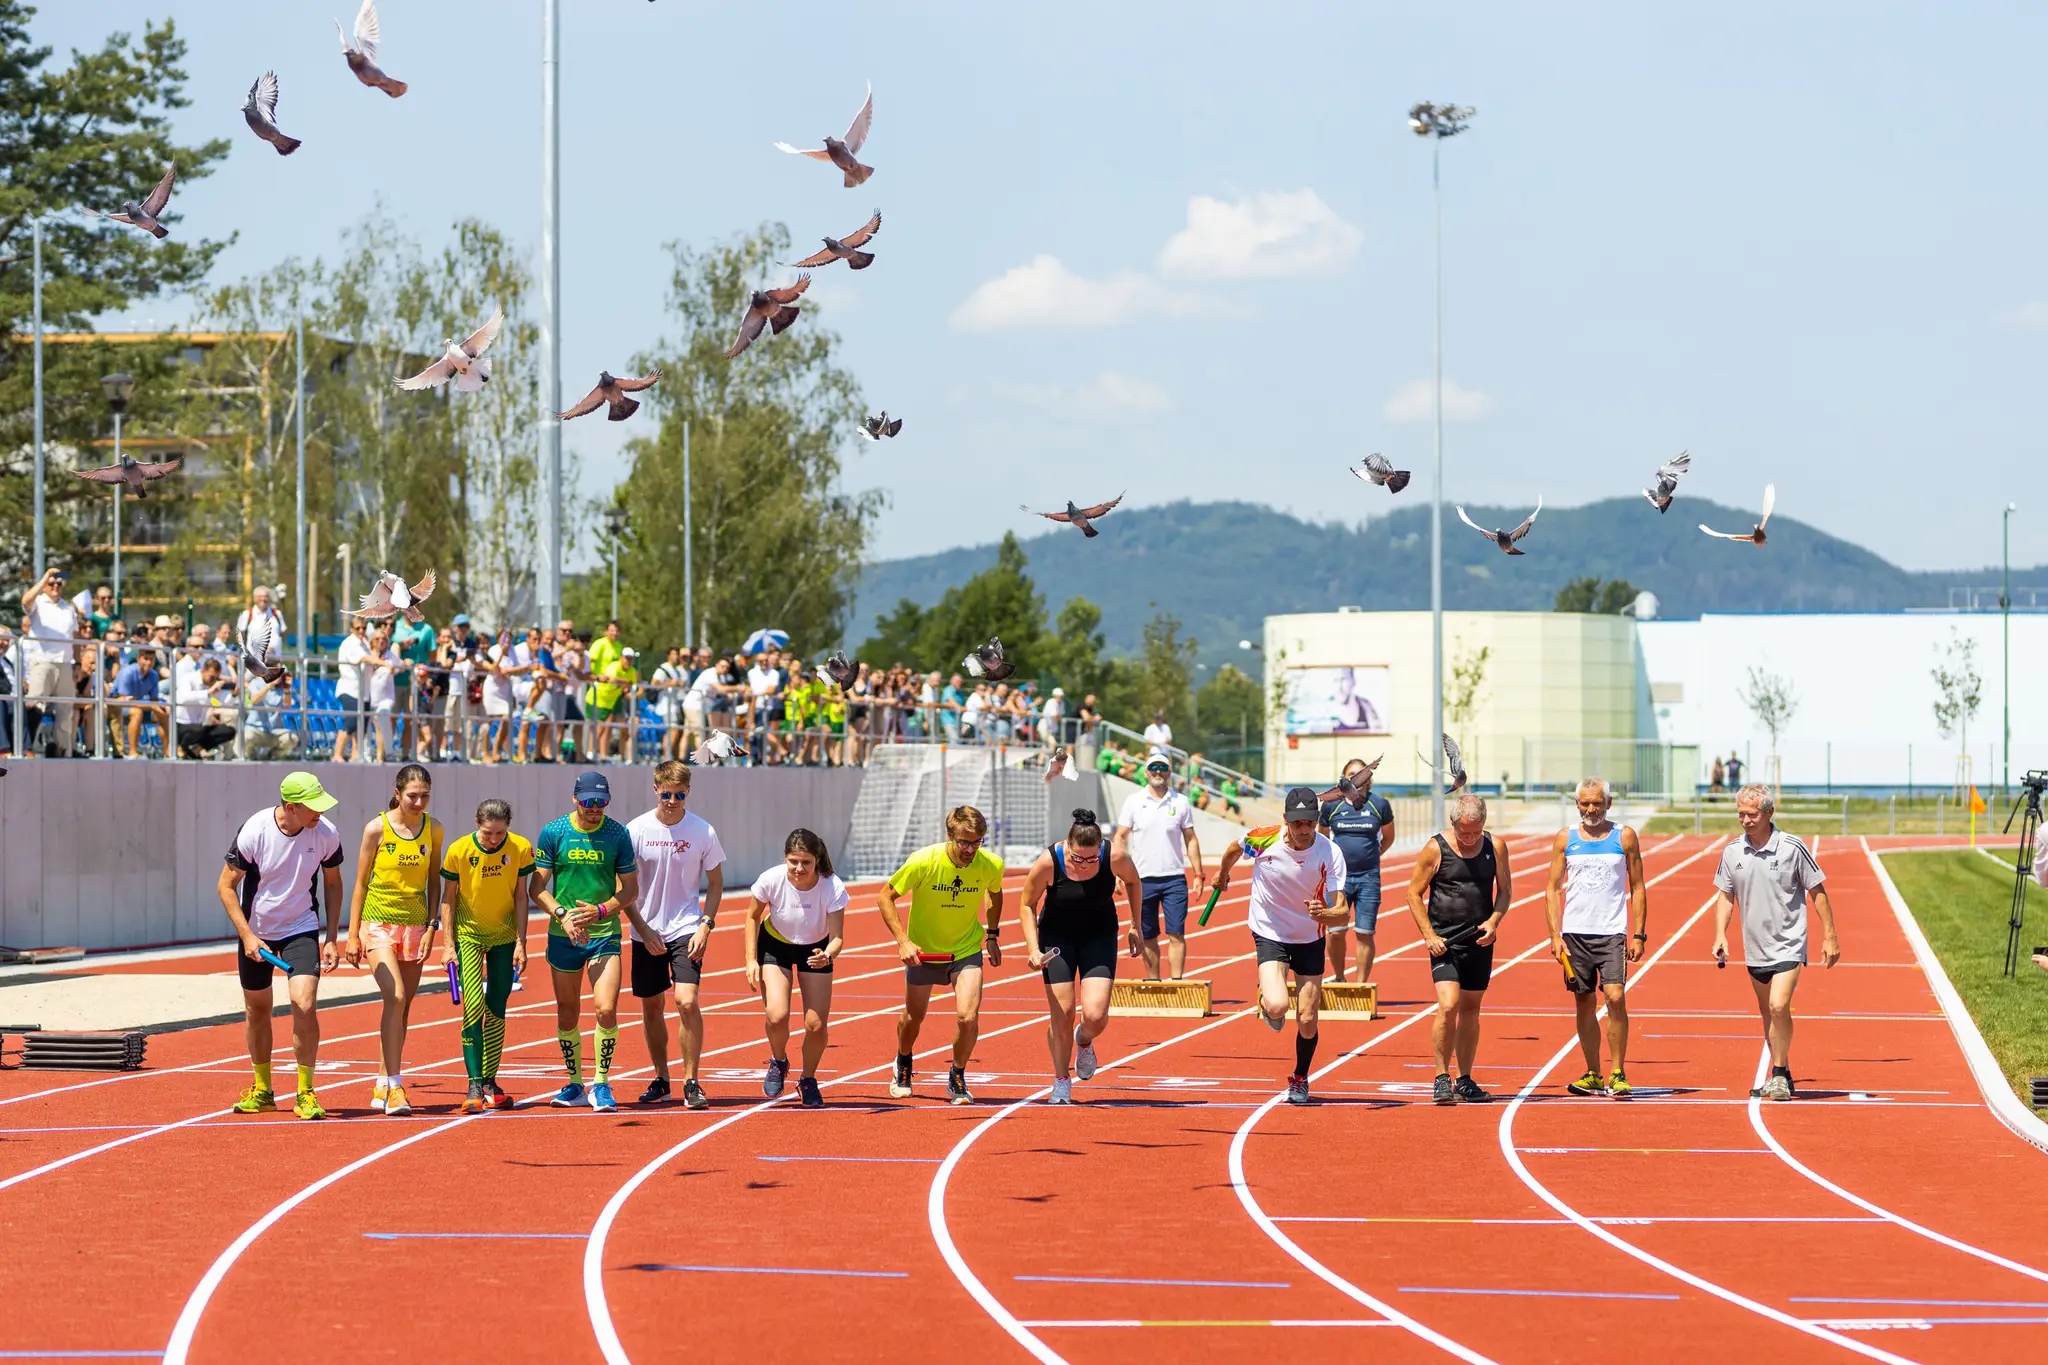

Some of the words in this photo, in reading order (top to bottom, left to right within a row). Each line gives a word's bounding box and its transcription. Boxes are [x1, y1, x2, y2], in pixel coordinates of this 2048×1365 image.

[645, 840, 679, 848] JUVENTA
[398, 853, 420, 861] ŠKP
[567, 846, 605, 862] eleven
[481, 865, 502, 873] ŠKP
